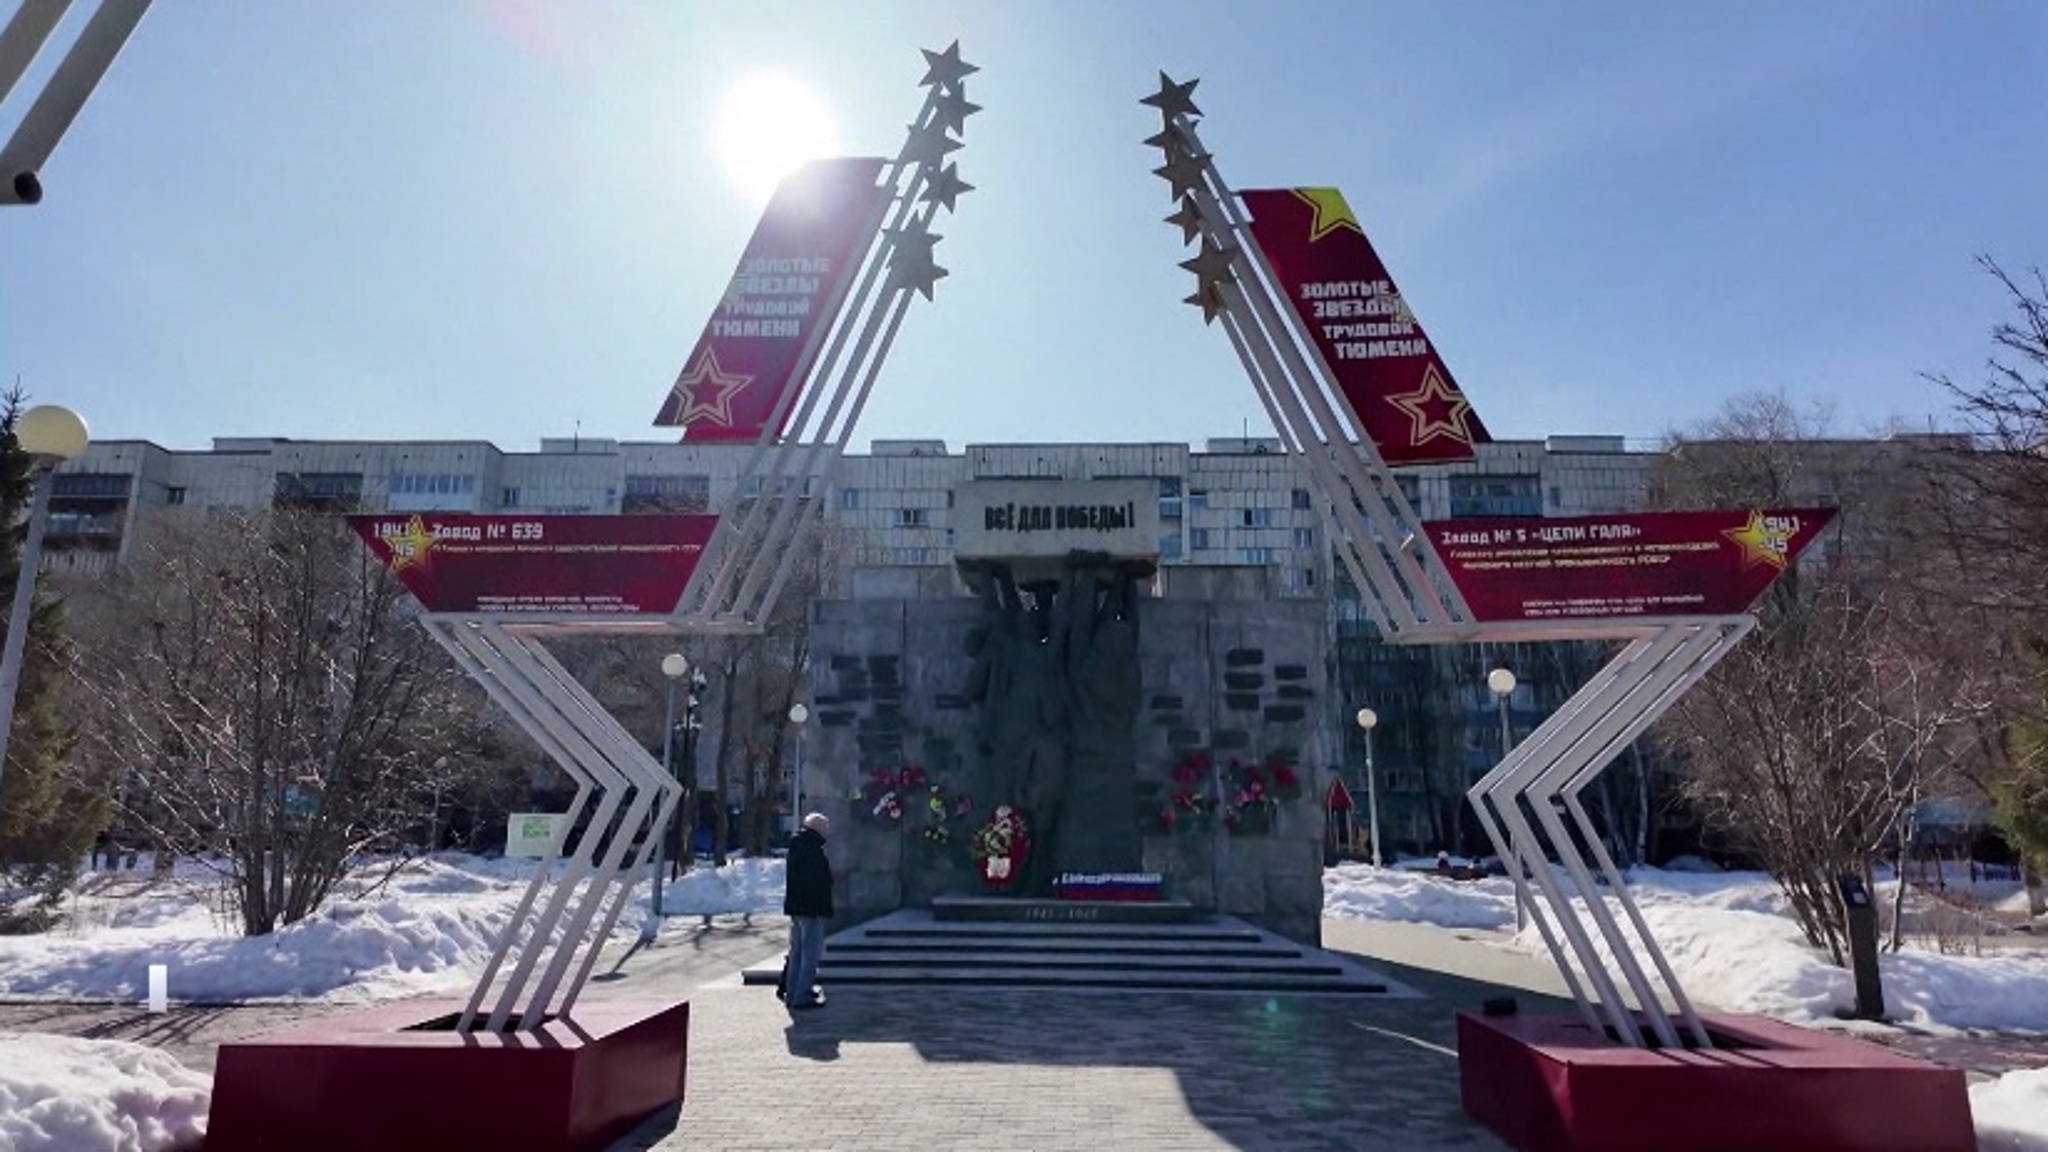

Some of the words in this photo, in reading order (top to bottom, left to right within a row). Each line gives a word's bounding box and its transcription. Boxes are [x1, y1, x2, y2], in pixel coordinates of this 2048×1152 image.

[1301, 280, 1390, 299] ЗОЛОТЫЕ
[1313, 298, 1400, 318] ЗВЕЗДЫ
[711, 319, 800, 337] ТЮМЕНИ
[1321, 320, 1414, 340] ТРУДОВОЙ
[1333, 339, 1428, 360] ТЮМЕНИ
[1017, 505, 1052, 533] ДЛЯ
[512, 522, 544, 540] 639
